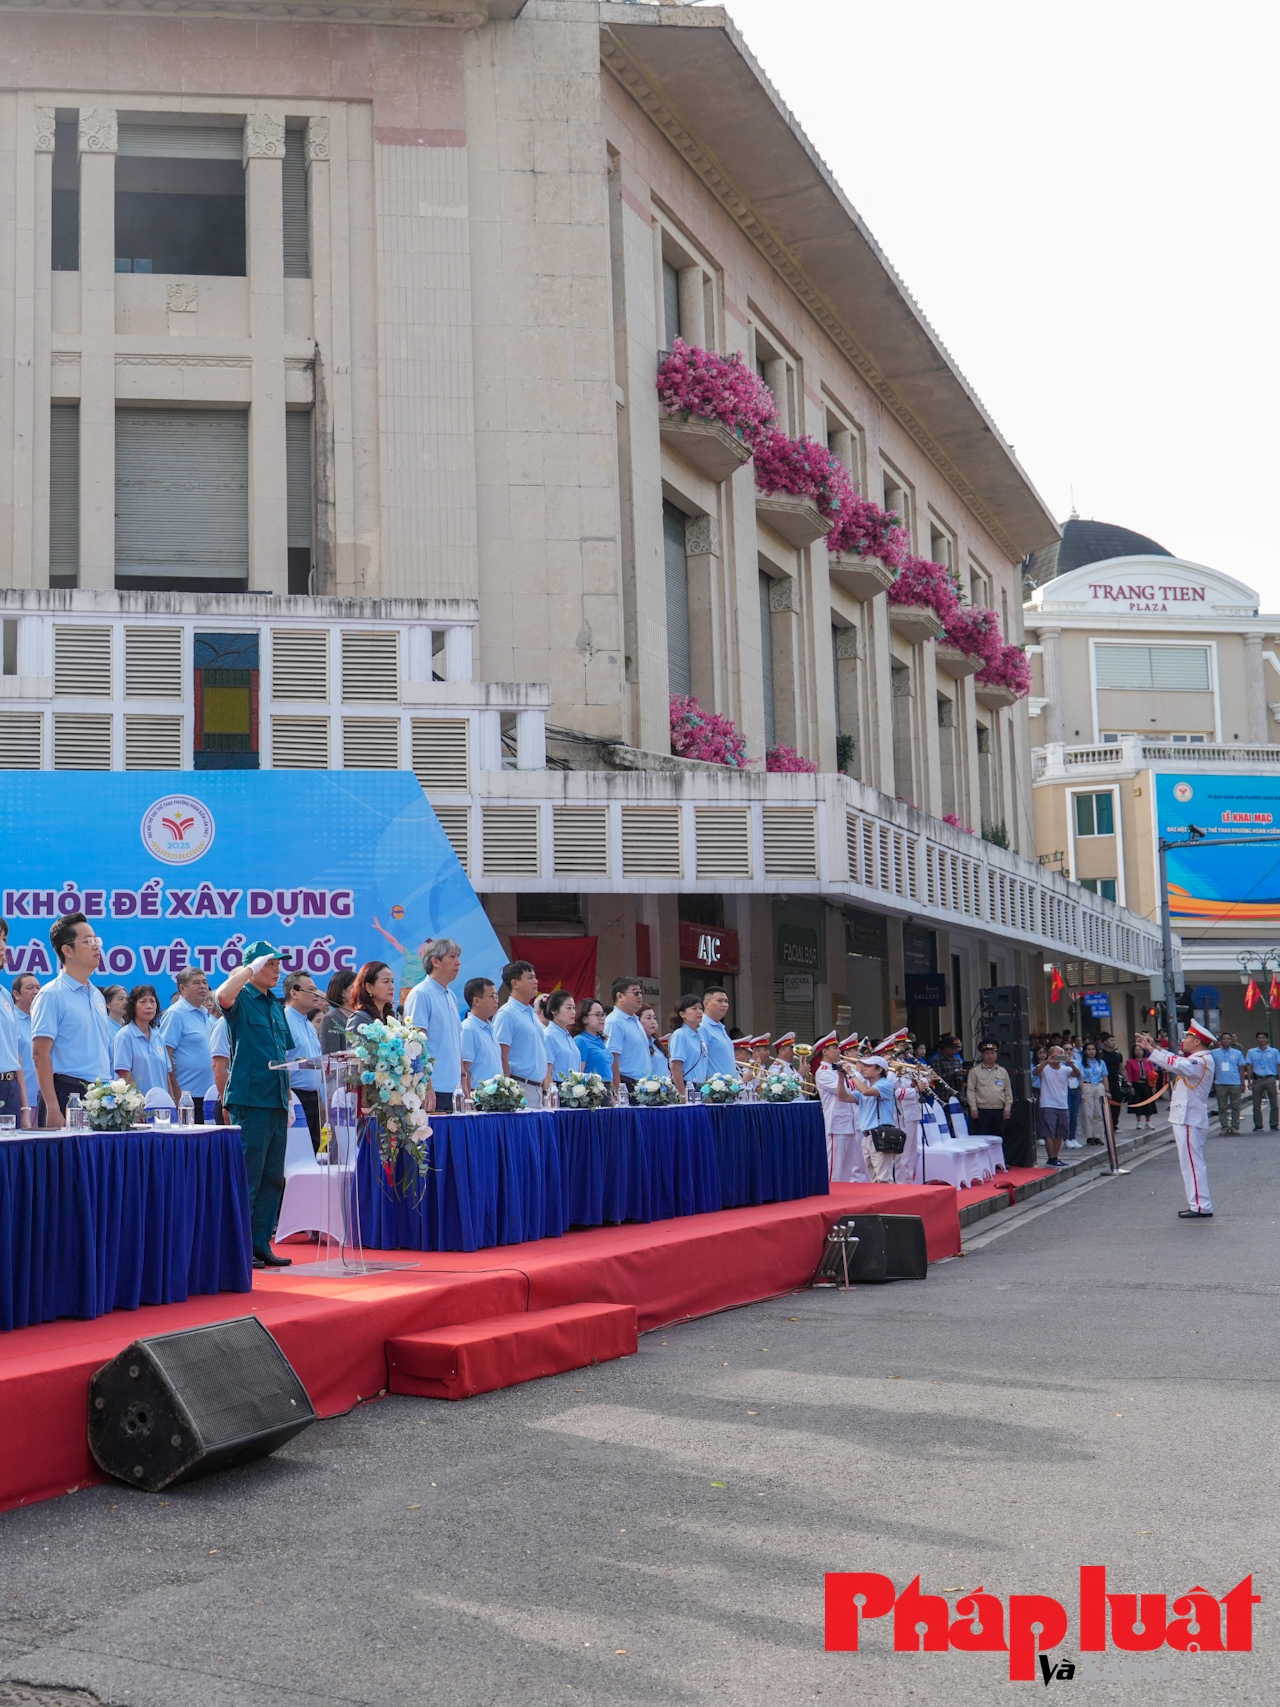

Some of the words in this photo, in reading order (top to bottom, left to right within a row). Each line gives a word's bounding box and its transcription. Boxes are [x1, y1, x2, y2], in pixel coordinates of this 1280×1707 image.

[1089, 584, 1155, 601] TRANG
[1158, 586, 1205, 601] TIEN
[1130, 603, 1168, 612] PLAZA
[1233, 813, 1252, 823] KHAI
[5, 883, 103, 916] KHỎE
[113, 880, 162, 916] ĐỂ
[169, 884, 240, 915] XÂY
[250, 889, 352, 925] DỰNG
[6, 942, 49, 972] VÀ
[198, 936, 242, 972] TỔ
[282, 938, 353, 972] UỐC
